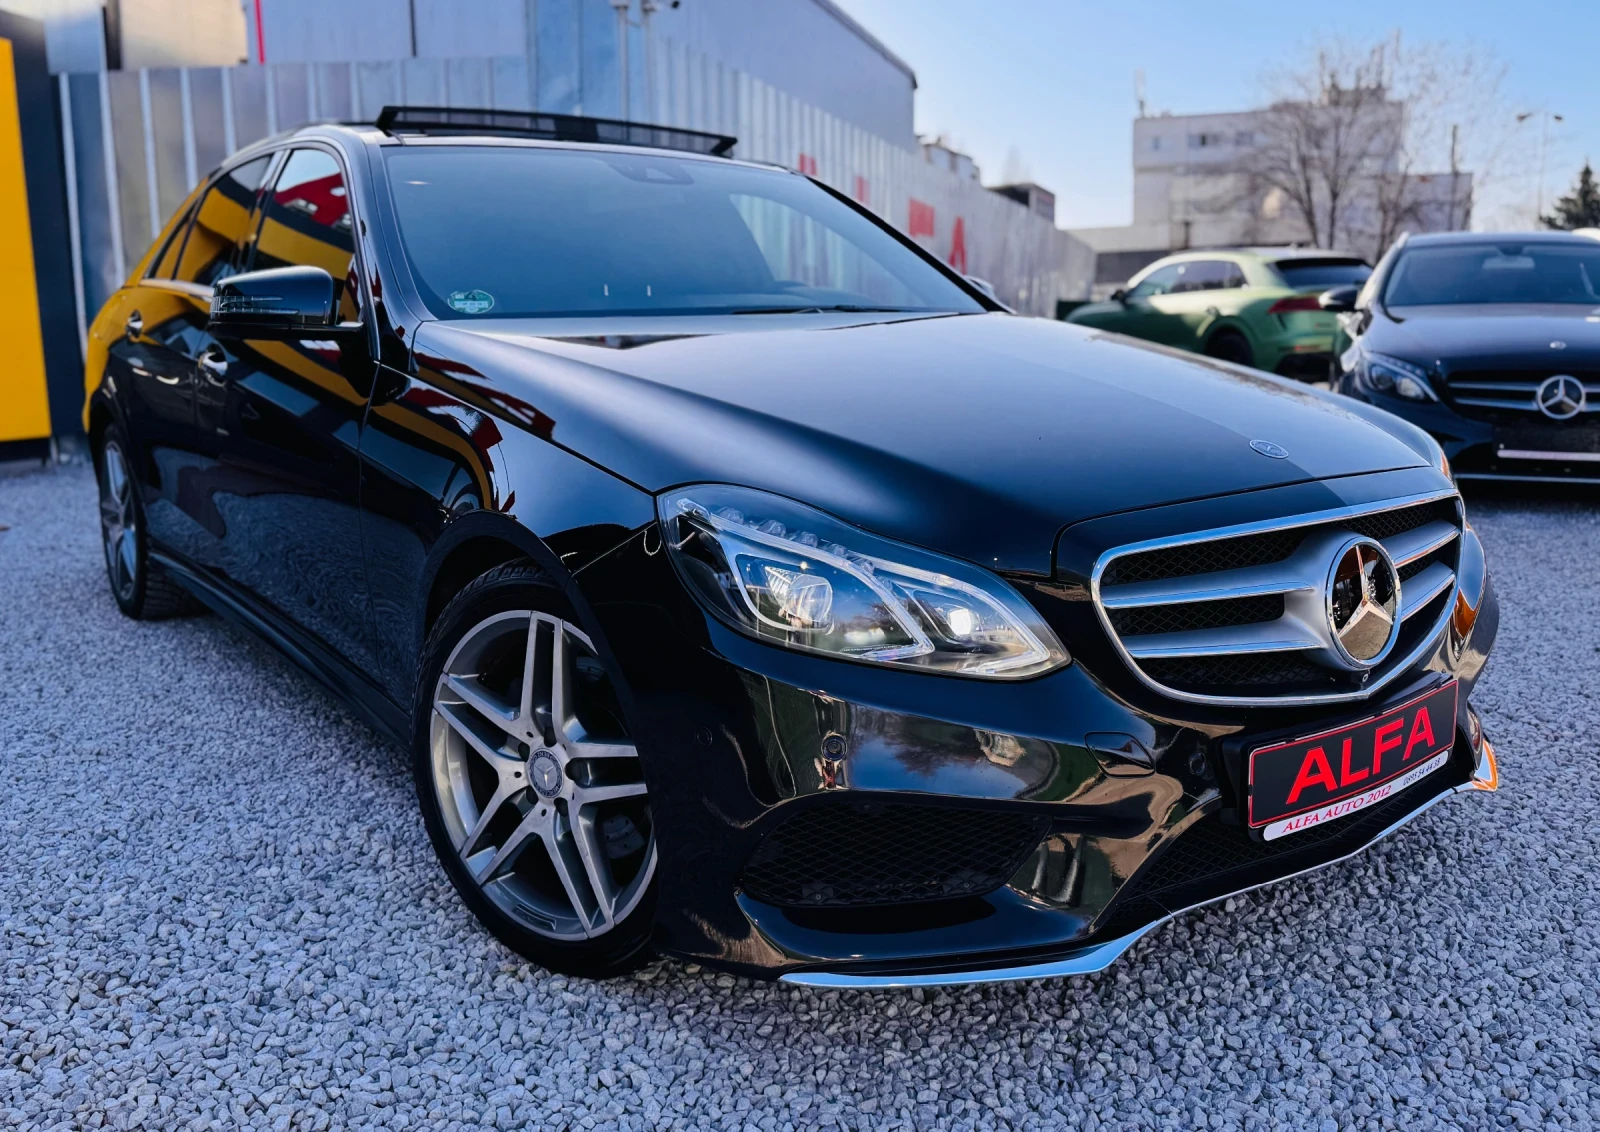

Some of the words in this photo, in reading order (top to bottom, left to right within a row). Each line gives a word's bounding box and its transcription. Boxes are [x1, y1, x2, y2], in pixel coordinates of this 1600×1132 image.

[1286, 706, 1435, 804] ALFA
[1282, 813, 1320, 834] ALFA
[1323, 797, 1364, 820] AUTO
[1366, 785, 1392, 804] 2012
